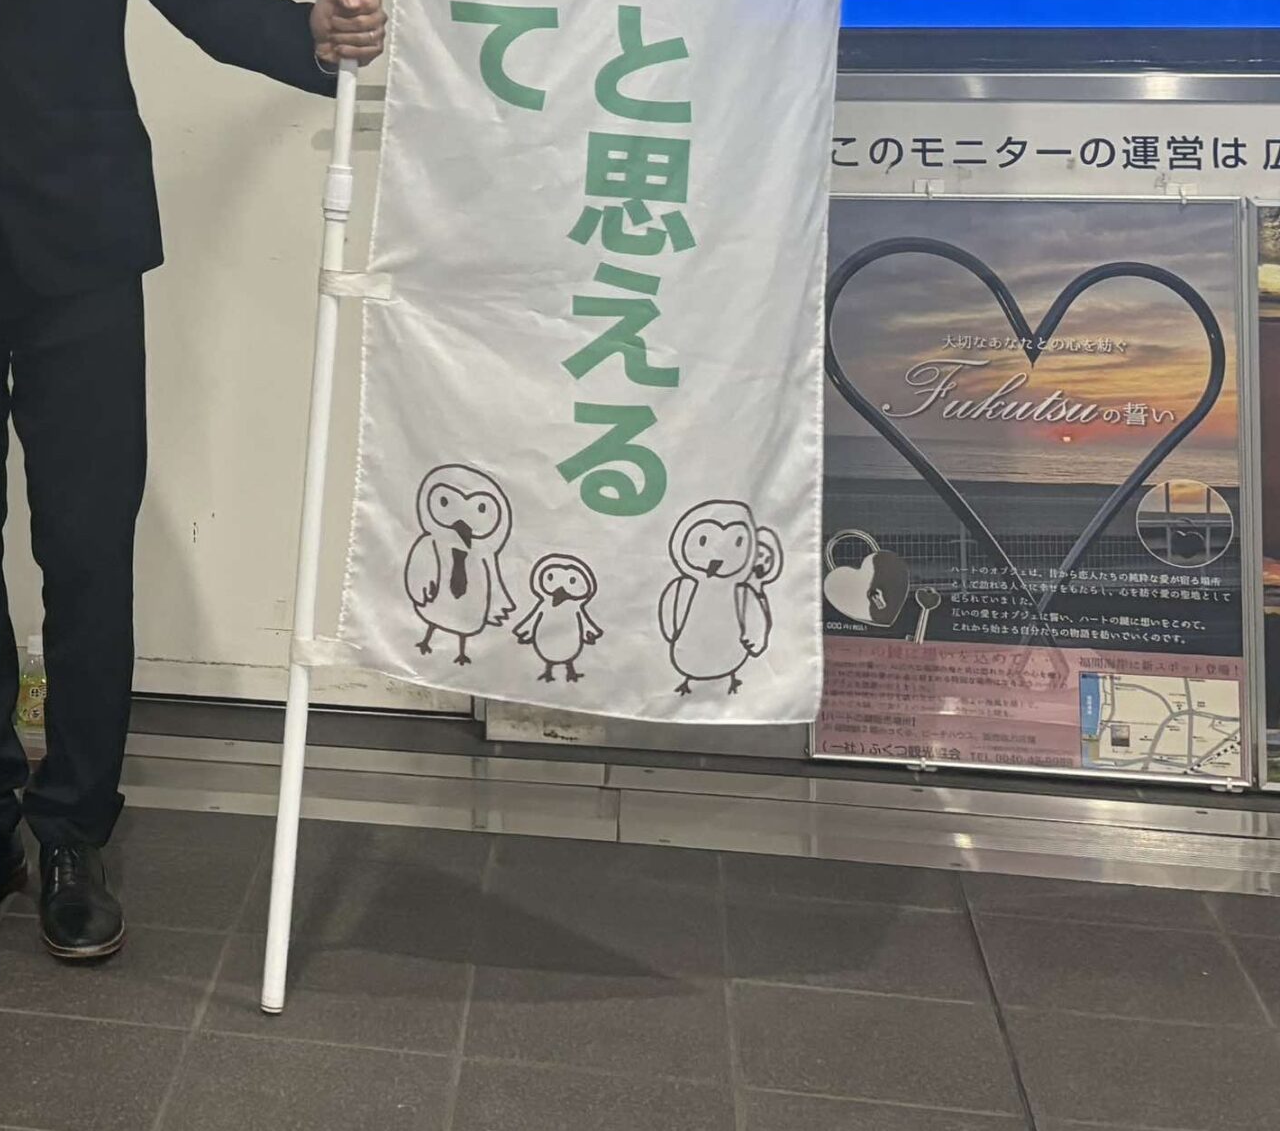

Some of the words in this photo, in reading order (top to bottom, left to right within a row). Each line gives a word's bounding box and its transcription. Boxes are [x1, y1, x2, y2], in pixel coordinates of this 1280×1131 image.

[942, 334, 1128, 353] 大切なあなたとの心を紡ぐ
